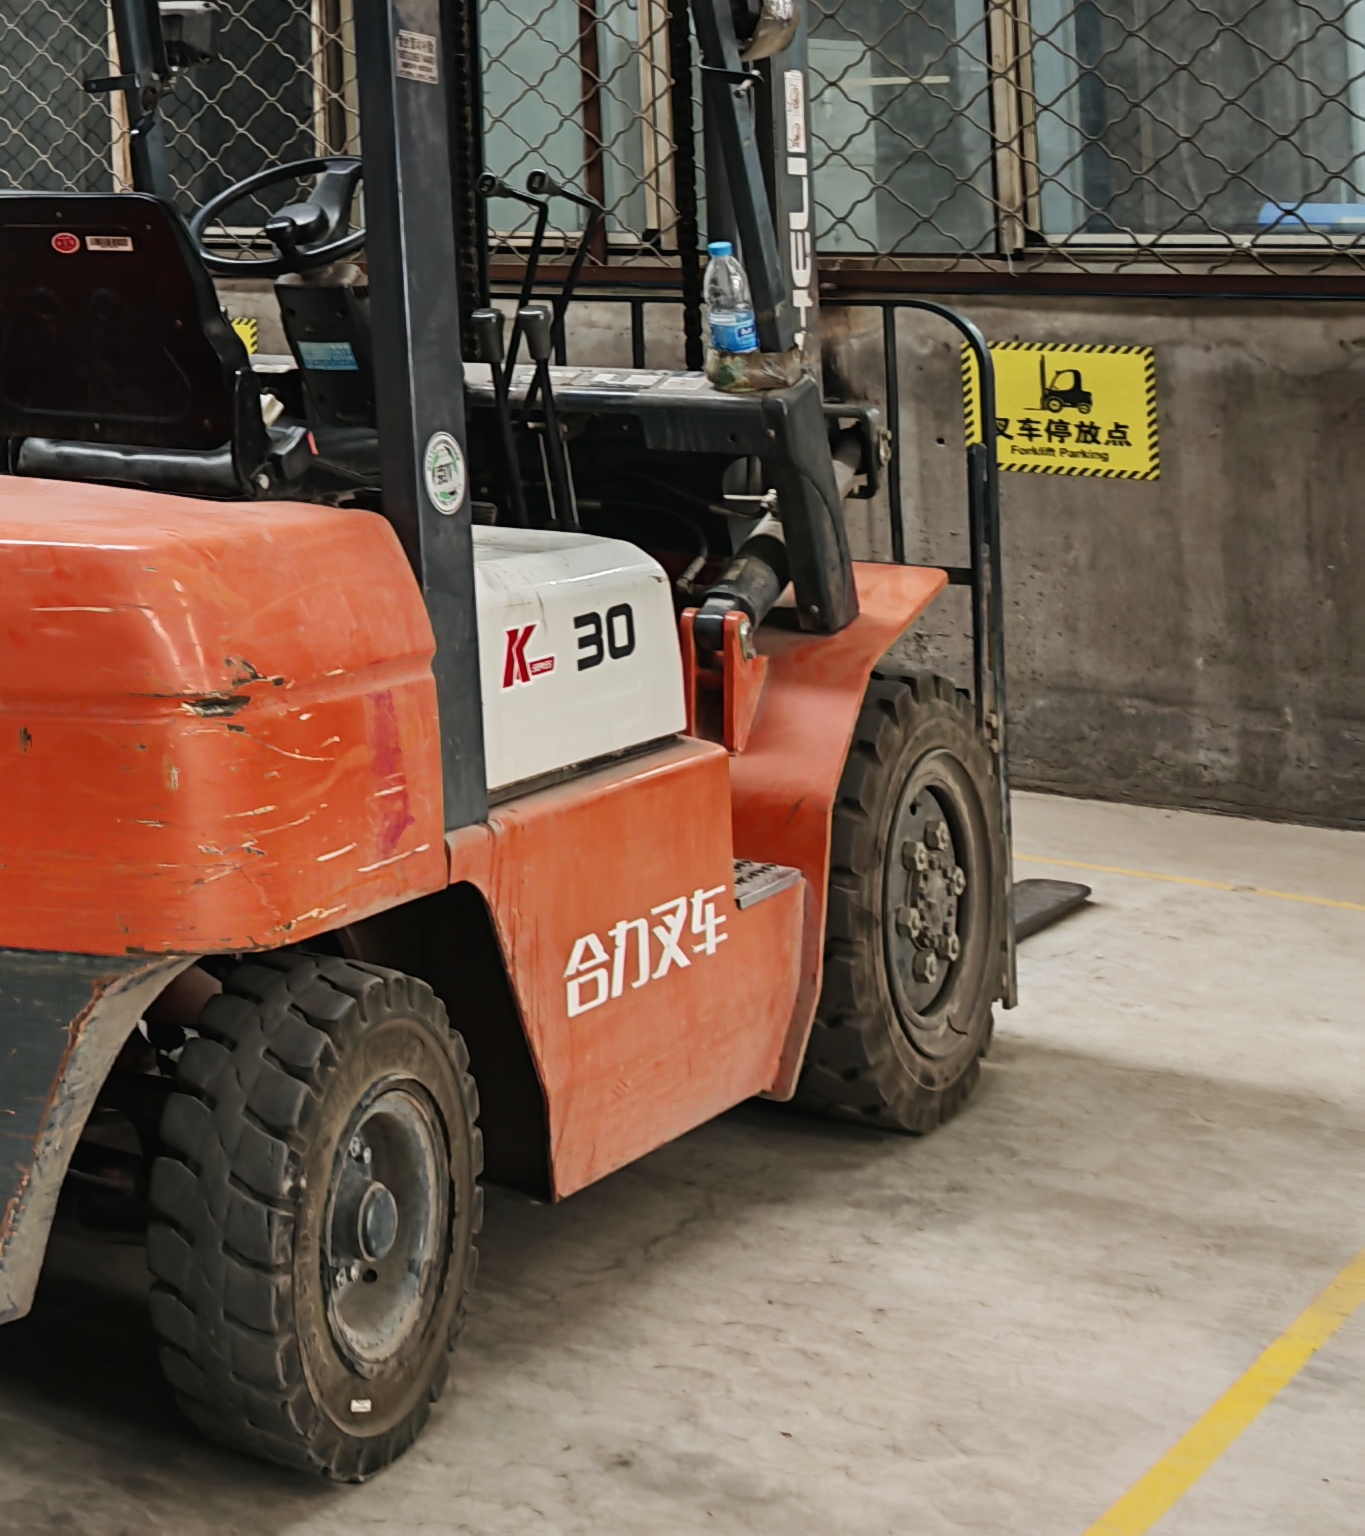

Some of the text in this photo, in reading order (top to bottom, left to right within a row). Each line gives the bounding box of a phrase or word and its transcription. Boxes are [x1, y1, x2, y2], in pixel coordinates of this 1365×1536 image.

[994, 417, 1133, 448] 叉车停放点
[1059, 447, 1110, 462] Parking
[502, 602, 636, 689] K 30
[563, 883, 729, 1020] 合力叉车
